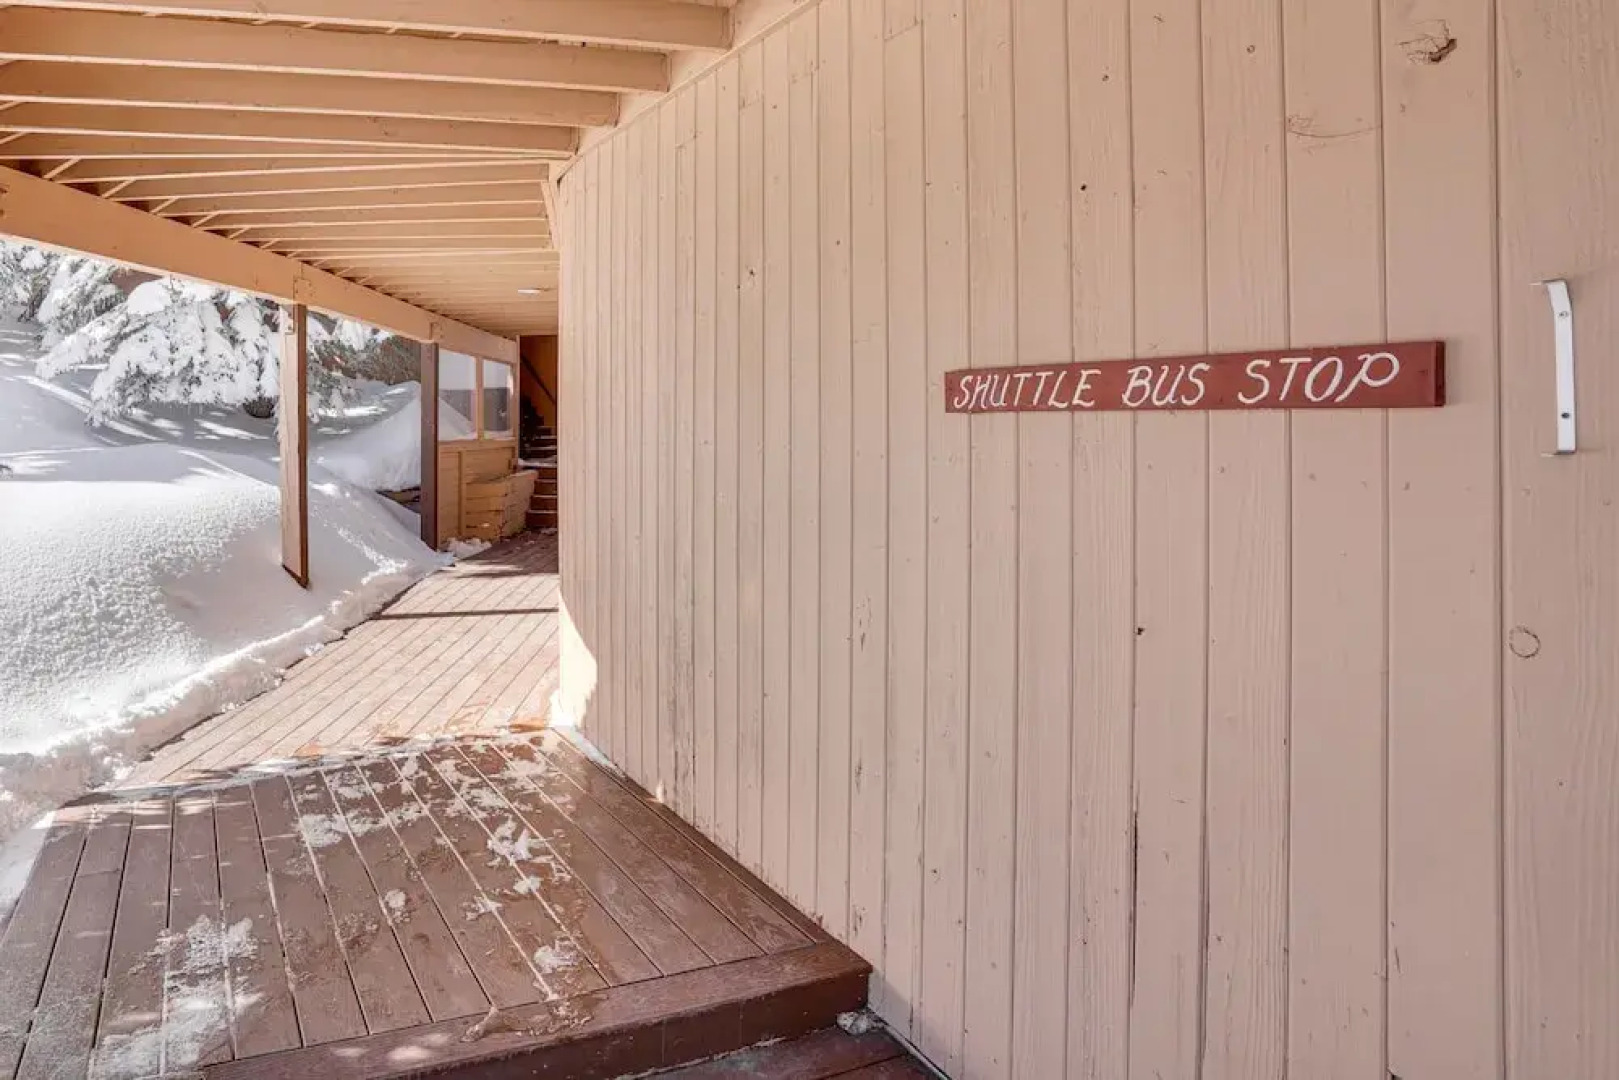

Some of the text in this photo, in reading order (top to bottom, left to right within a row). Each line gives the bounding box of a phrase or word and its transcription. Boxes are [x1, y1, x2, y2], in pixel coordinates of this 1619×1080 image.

[953, 352, 1400, 410] SHUTTLE BUS STOP
